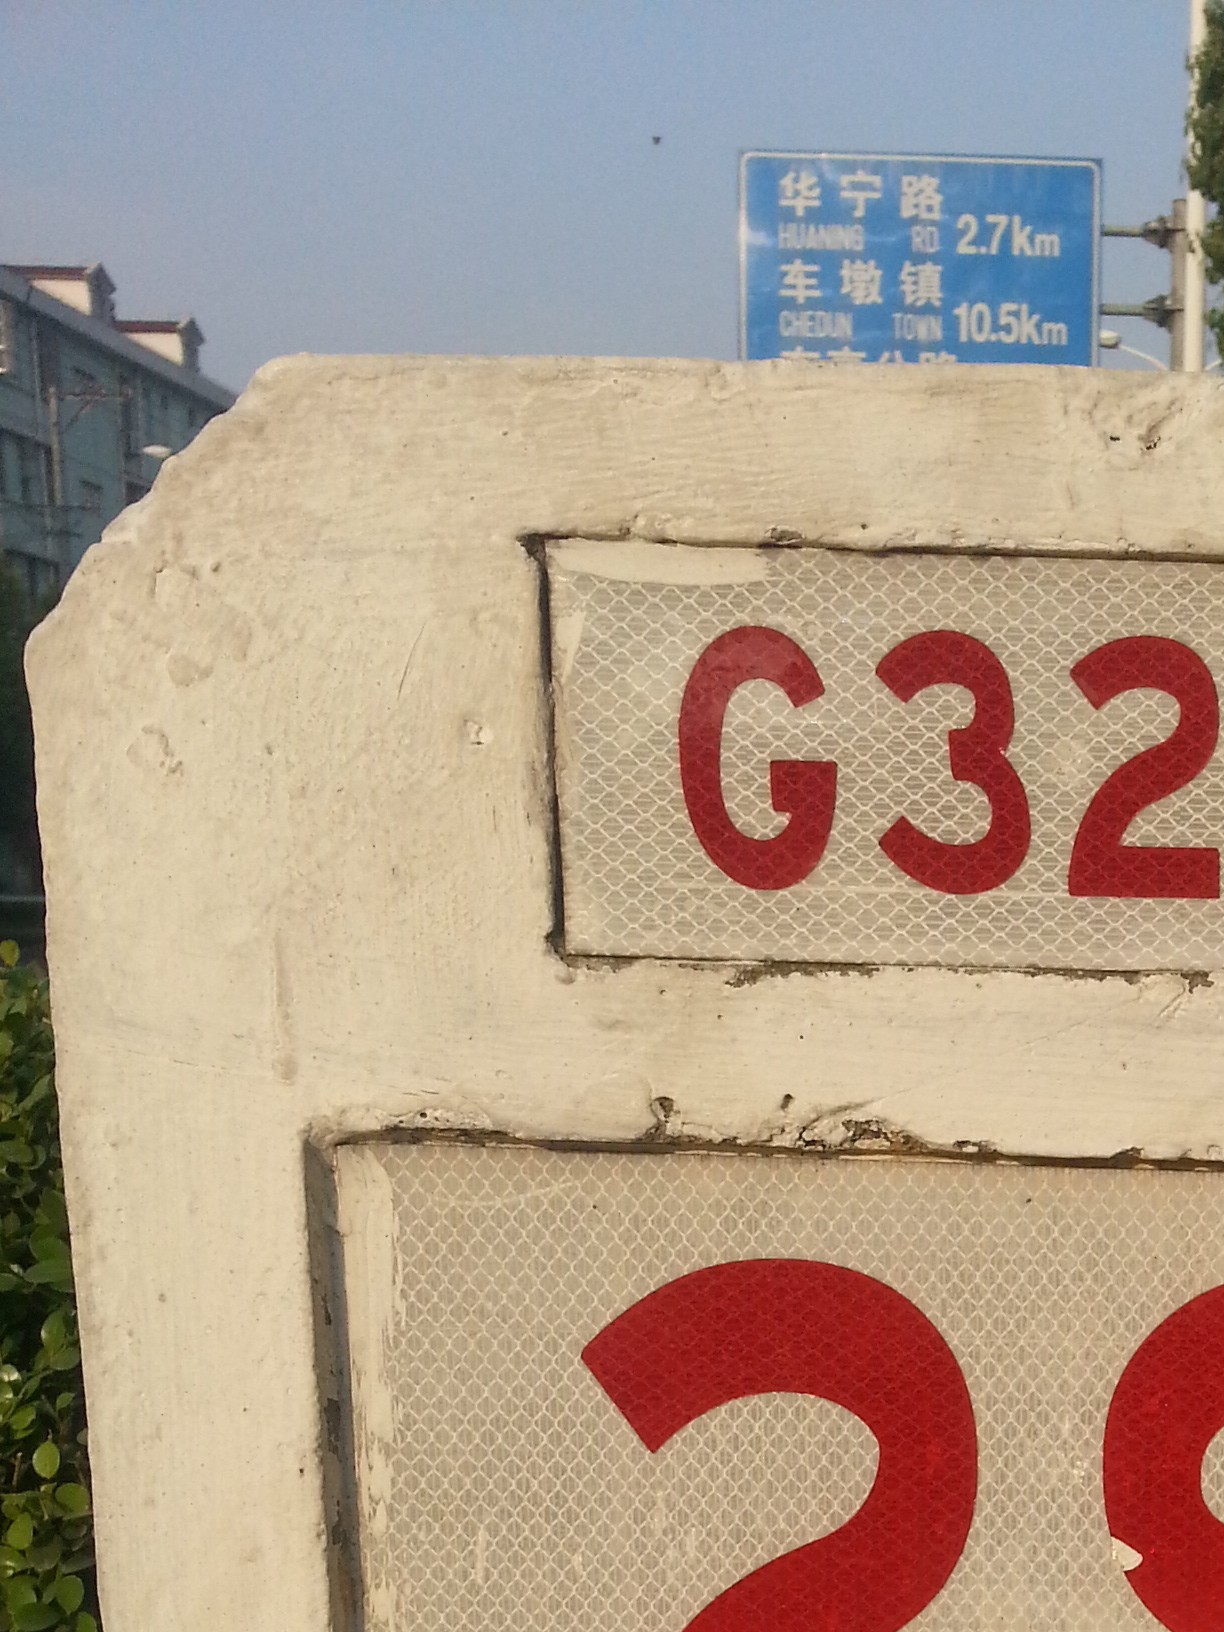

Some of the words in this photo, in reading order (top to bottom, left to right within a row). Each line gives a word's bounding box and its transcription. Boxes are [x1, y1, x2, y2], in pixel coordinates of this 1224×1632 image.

[778, 169, 944, 221] 华宁路
[778, 258, 944, 308] 车墩镇
[778, 310, 854, 339] CHEDUN
[892, 312, 943, 342] TOWN
